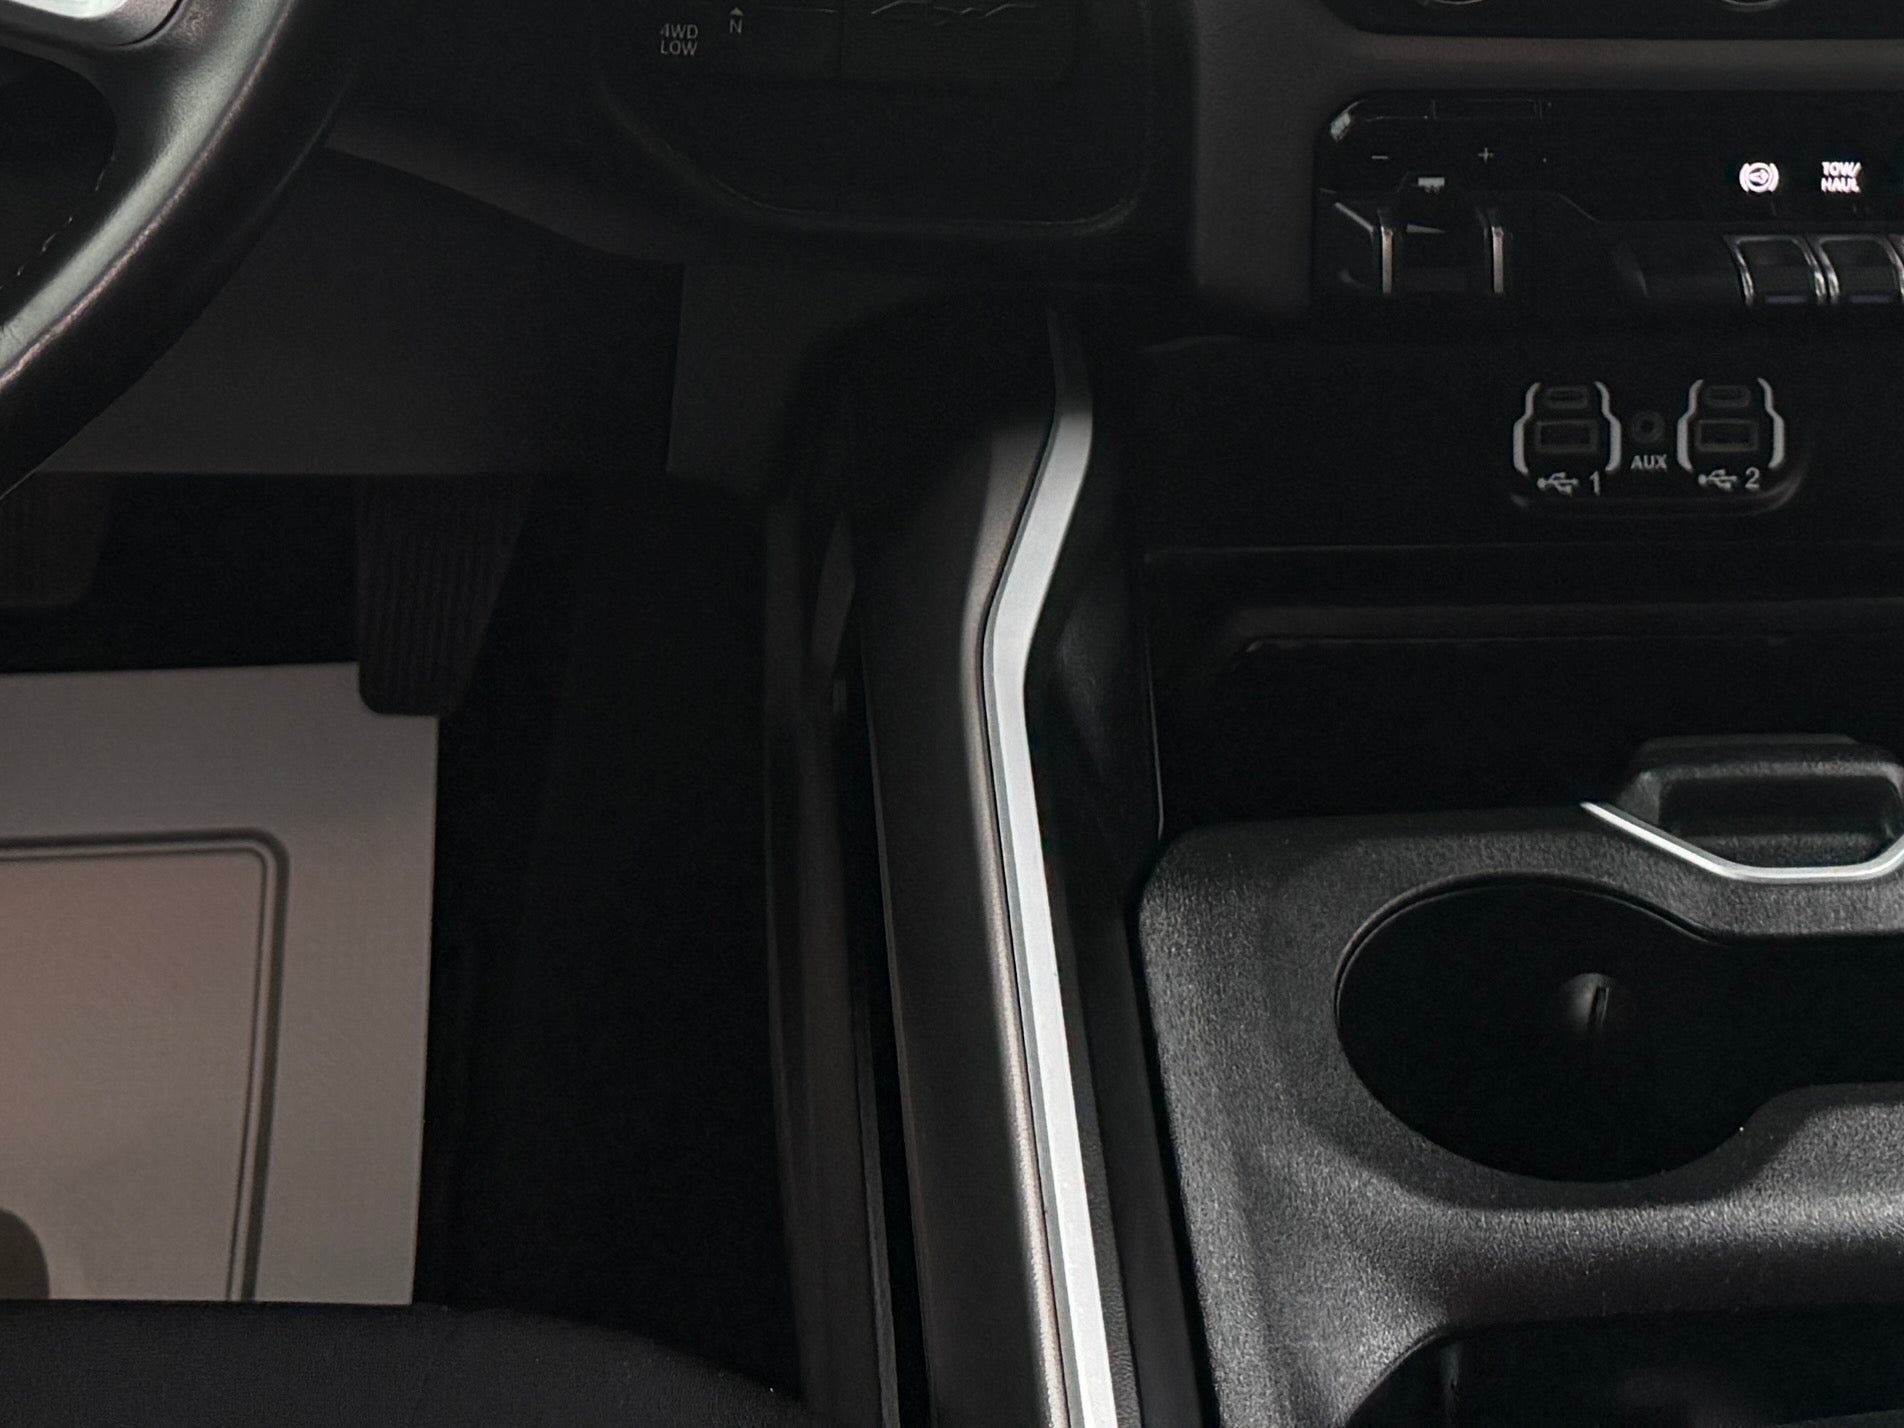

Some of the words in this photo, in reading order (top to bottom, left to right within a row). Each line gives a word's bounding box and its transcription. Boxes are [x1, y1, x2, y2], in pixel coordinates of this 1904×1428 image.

[660, 24, 698, 39] 4WD
[729, 20, 742, 34] N
[661, 40, 697, 56] LOW
[1822, 161, 1862, 178] TOW/
[1821, 177, 1861, 193] HAUL
[1630, 453, 1667, 471] AUX
[1590, 472, 1601, 494] 1
[1745, 467, 1760, 490] 2
